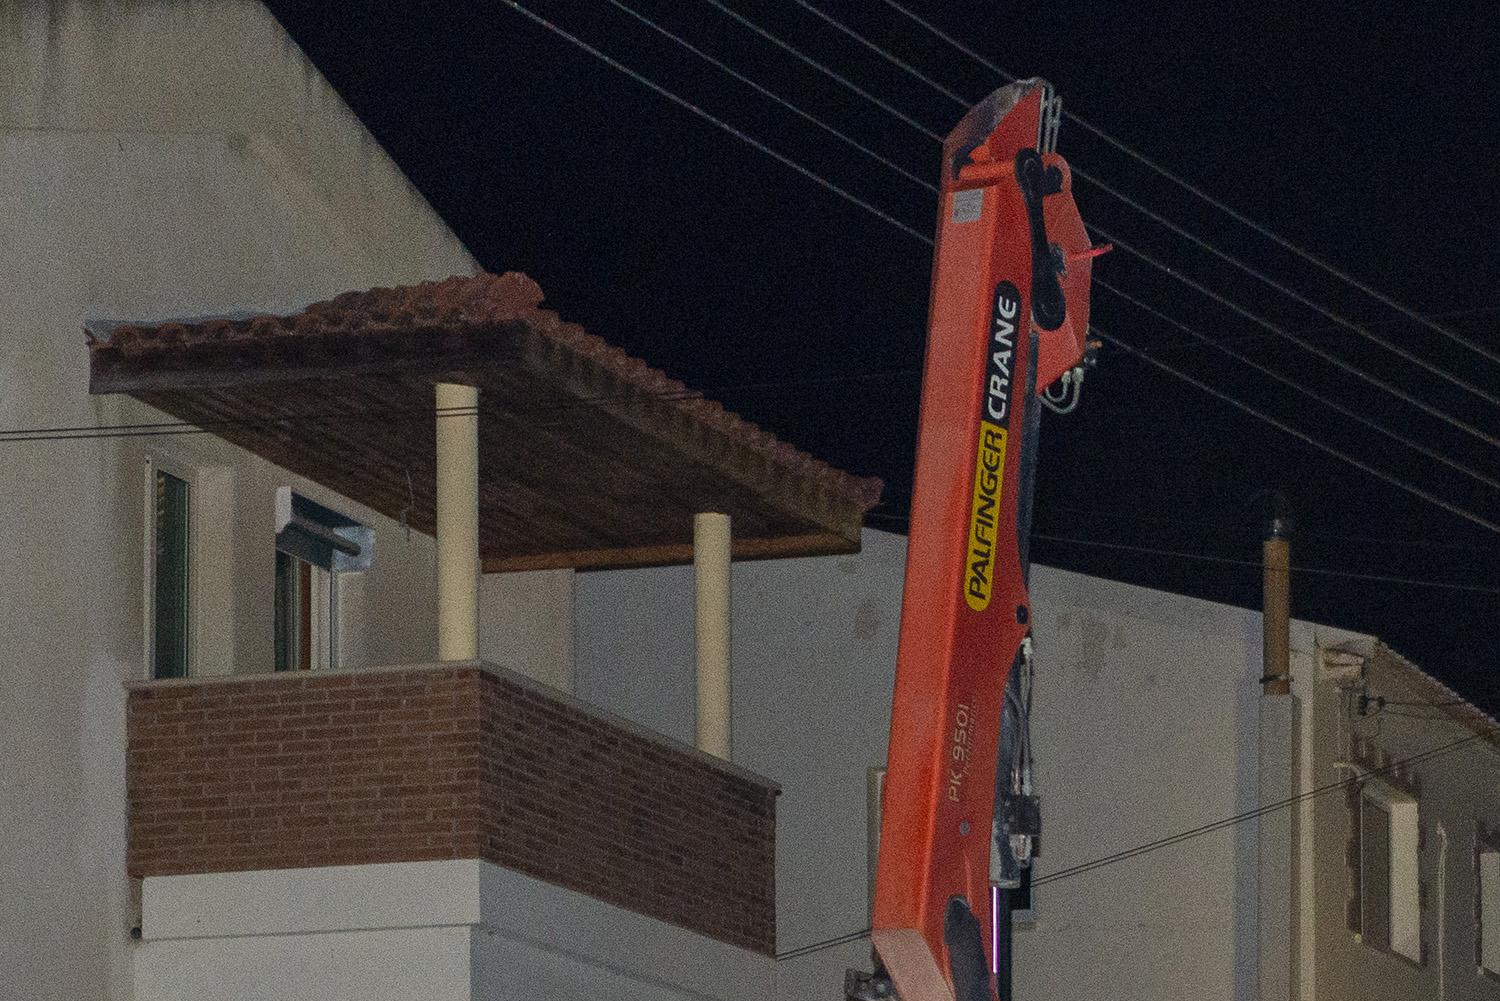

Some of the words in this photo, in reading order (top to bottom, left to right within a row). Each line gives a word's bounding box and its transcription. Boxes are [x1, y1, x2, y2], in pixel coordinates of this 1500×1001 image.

[969, 429, 1003, 600] PALFINGER
[988, 295, 1017, 420] CRANE
[948, 768, 962, 802] PK
